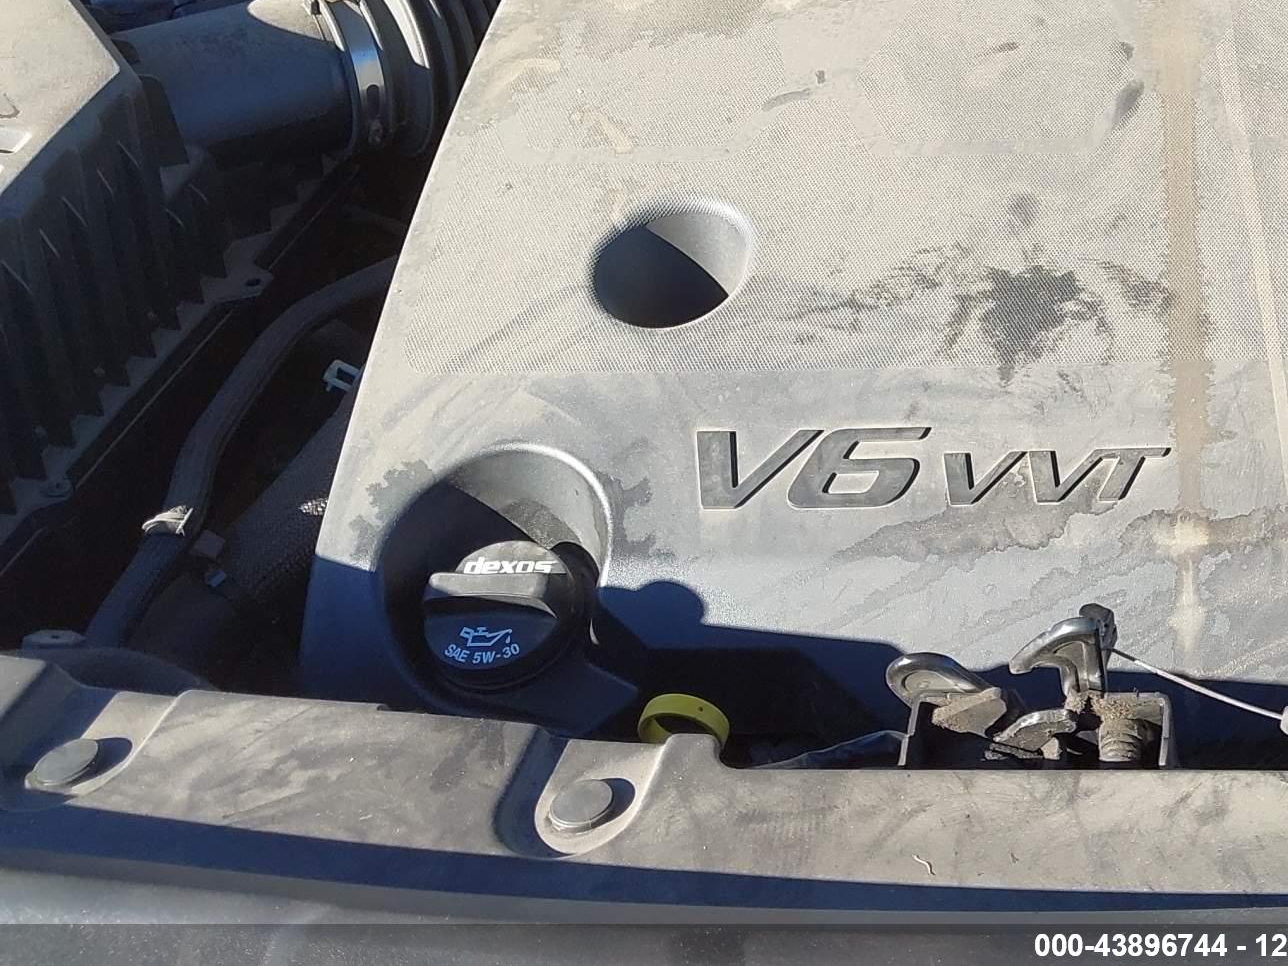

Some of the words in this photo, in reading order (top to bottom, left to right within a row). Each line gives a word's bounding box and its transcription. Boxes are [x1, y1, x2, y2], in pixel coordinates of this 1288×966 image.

[696, 426, 932, 511] V6
[943, 446, 1172, 507] VVT
[463, 556, 559, 575] dexos
[444, 643, 470, 663] SAE
[472, 642, 521, 665] 5W-30
